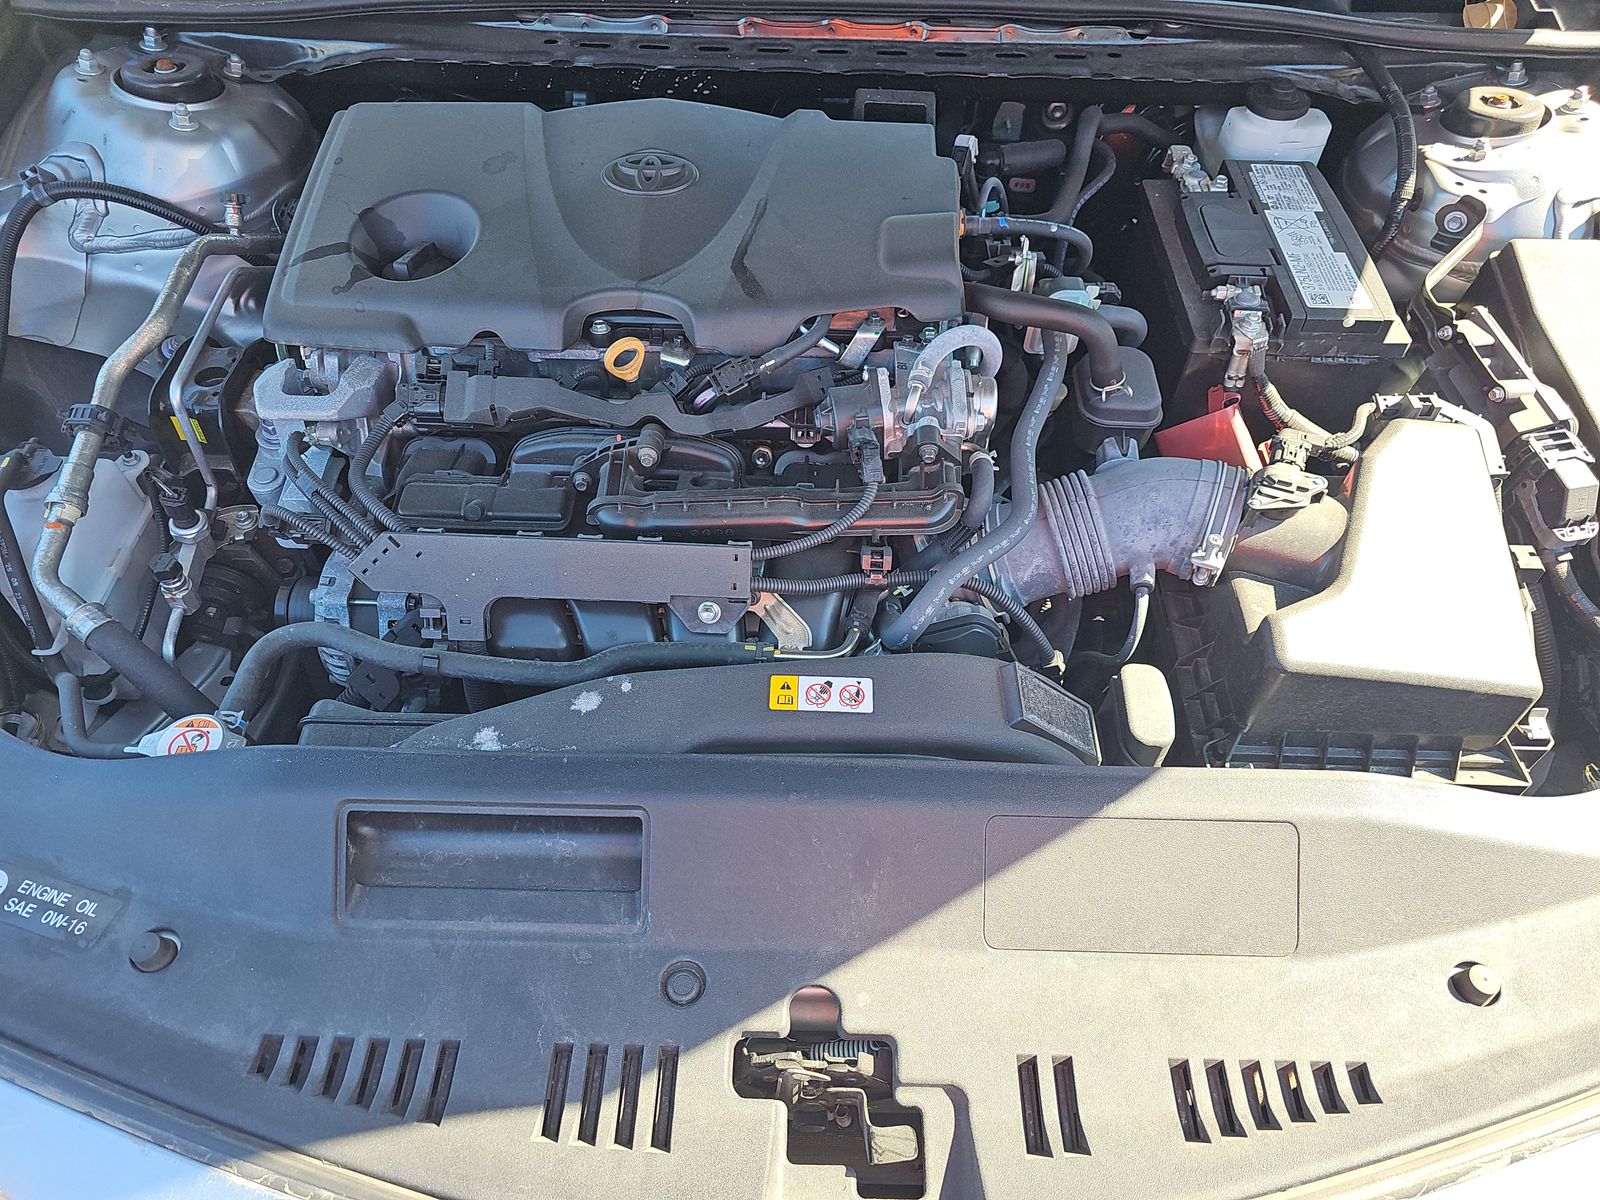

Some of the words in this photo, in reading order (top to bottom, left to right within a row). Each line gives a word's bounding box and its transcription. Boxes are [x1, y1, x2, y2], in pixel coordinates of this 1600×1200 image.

[3, 897, 38, 918] SAE
[41, 910, 88, 935] 0W-16
[17, 879, 72, 907] ENGINE
[75, 899, 98, 917] OIL
